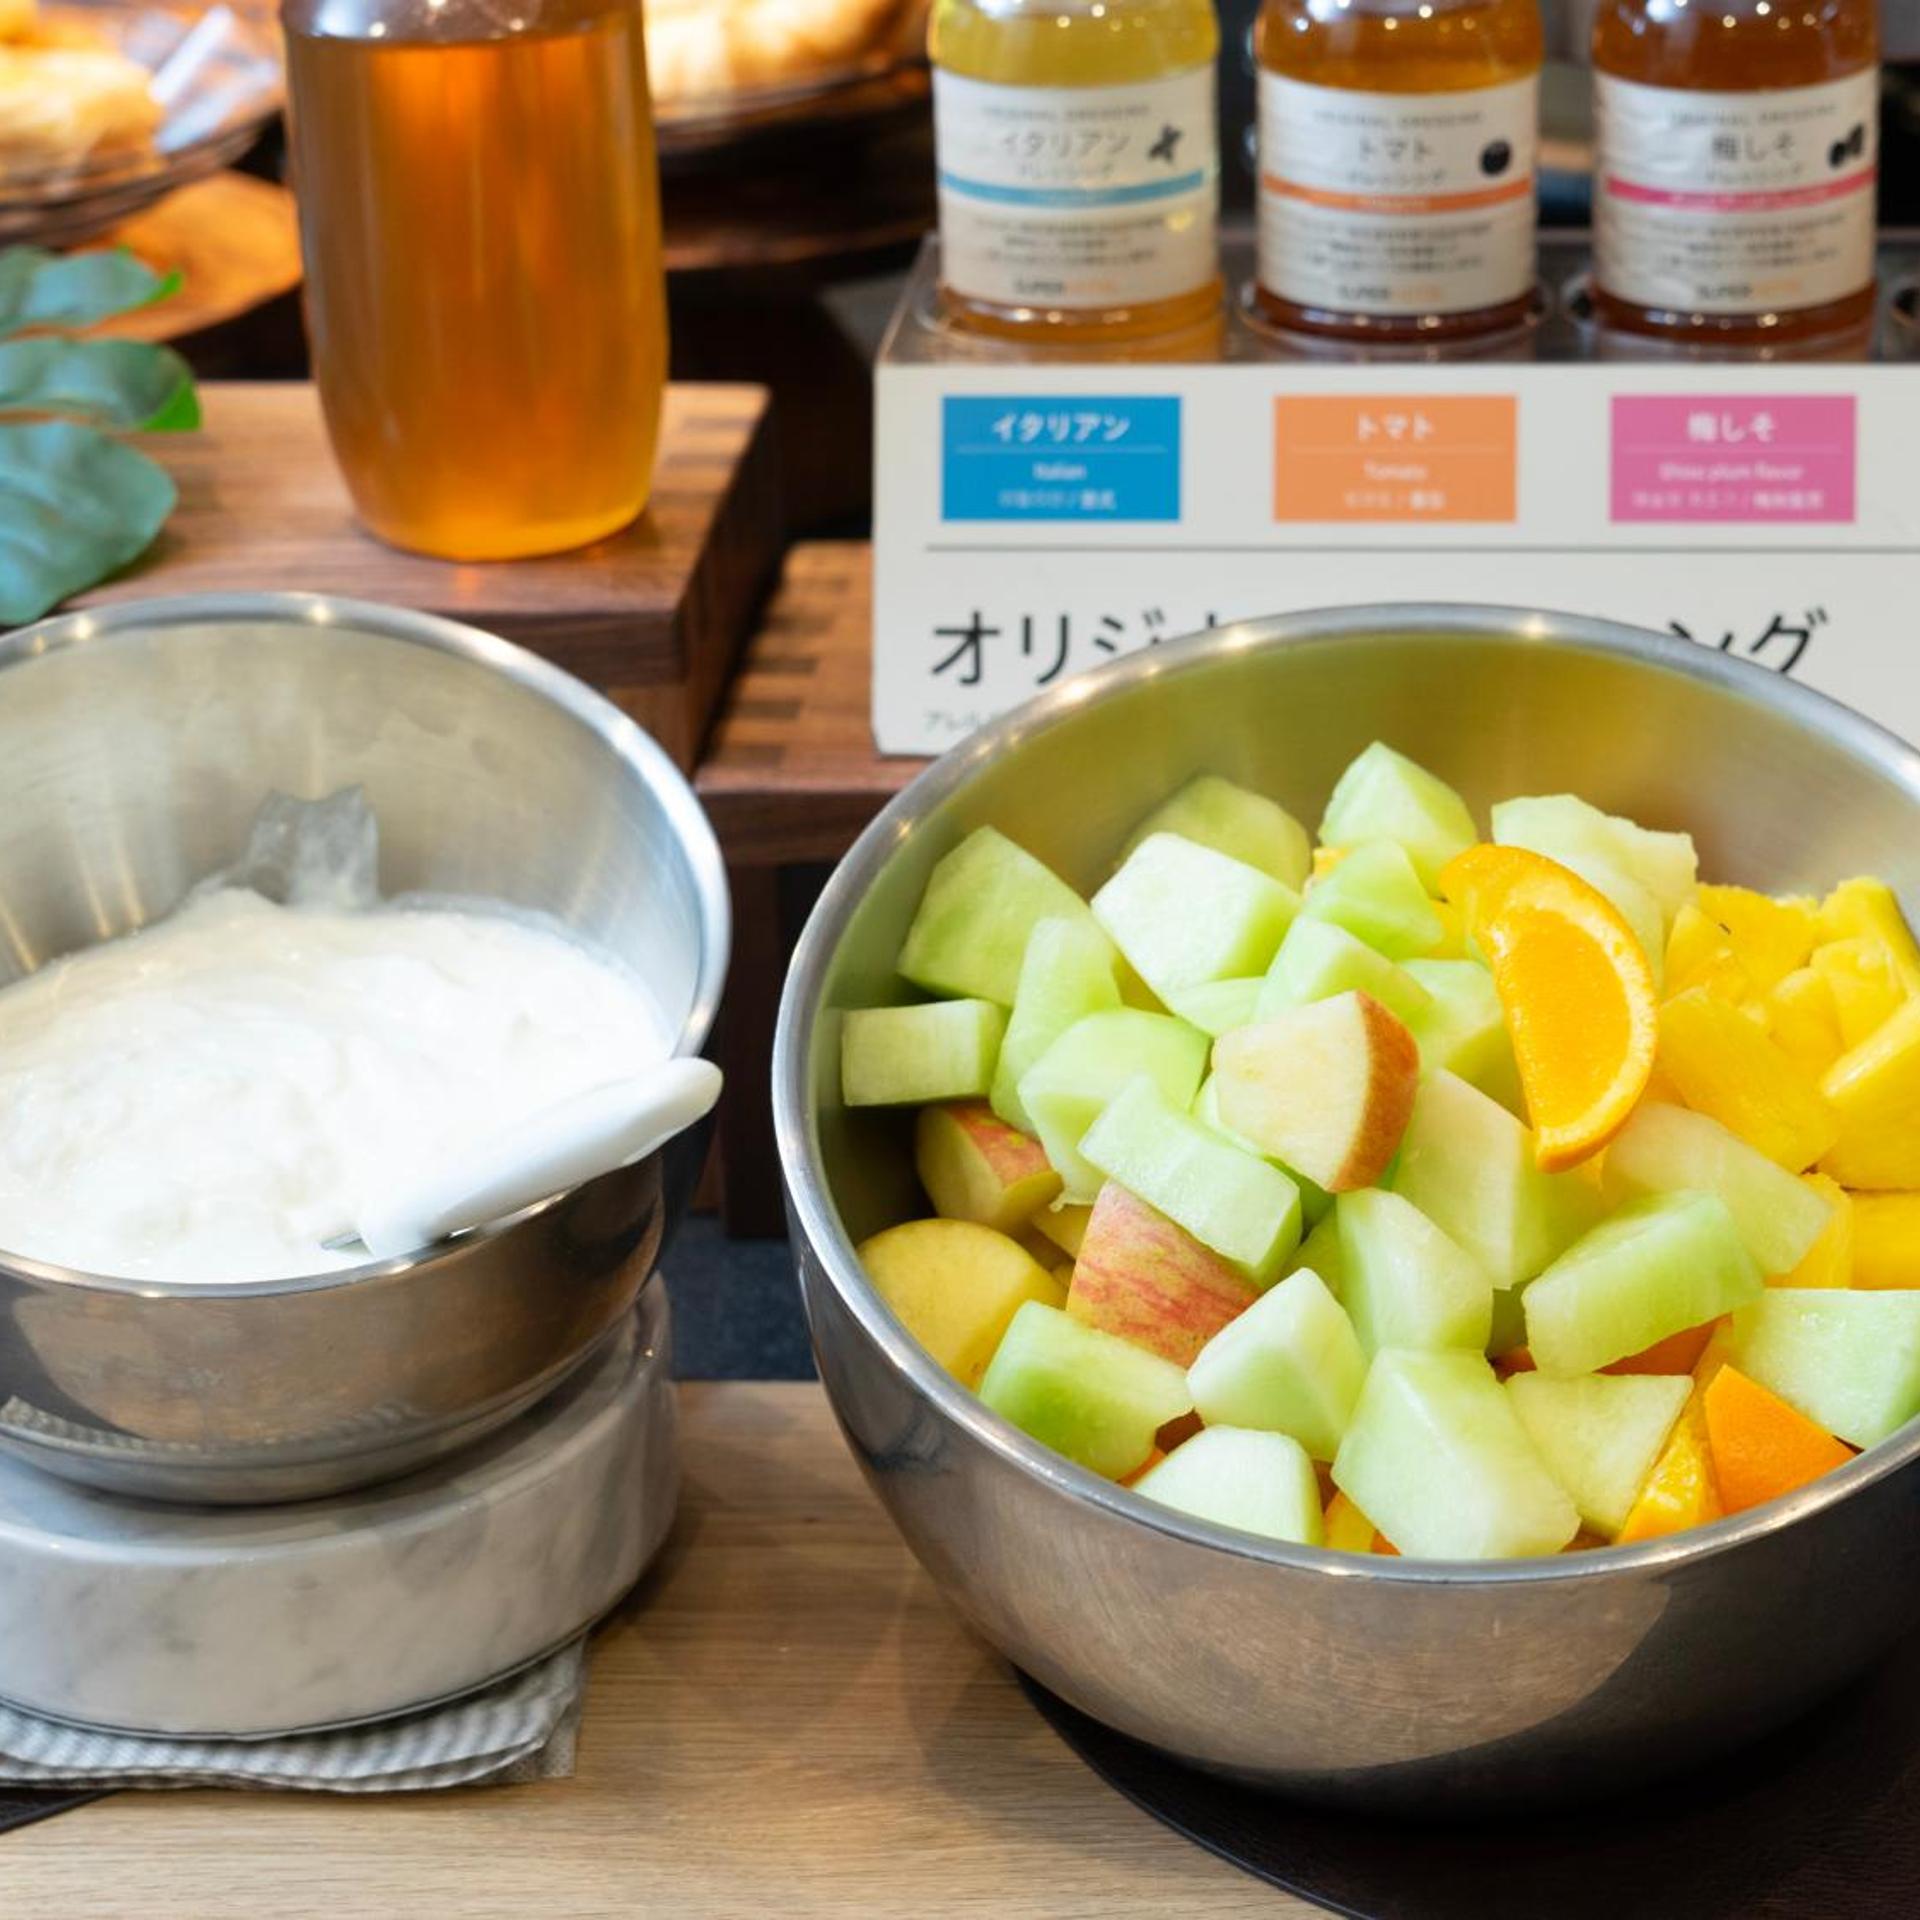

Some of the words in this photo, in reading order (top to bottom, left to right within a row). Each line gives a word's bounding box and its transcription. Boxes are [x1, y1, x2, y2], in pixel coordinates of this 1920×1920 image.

[1001, 128, 1133, 154] イタリアン
[1358, 135, 1432, 163] トマト
[1711, 132, 1795, 161] 梅しそ
[993, 411, 1131, 443] イタリアン
[1358, 411, 1434, 442] トマト
[1687, 411, 1776, 443] 梅しそ
